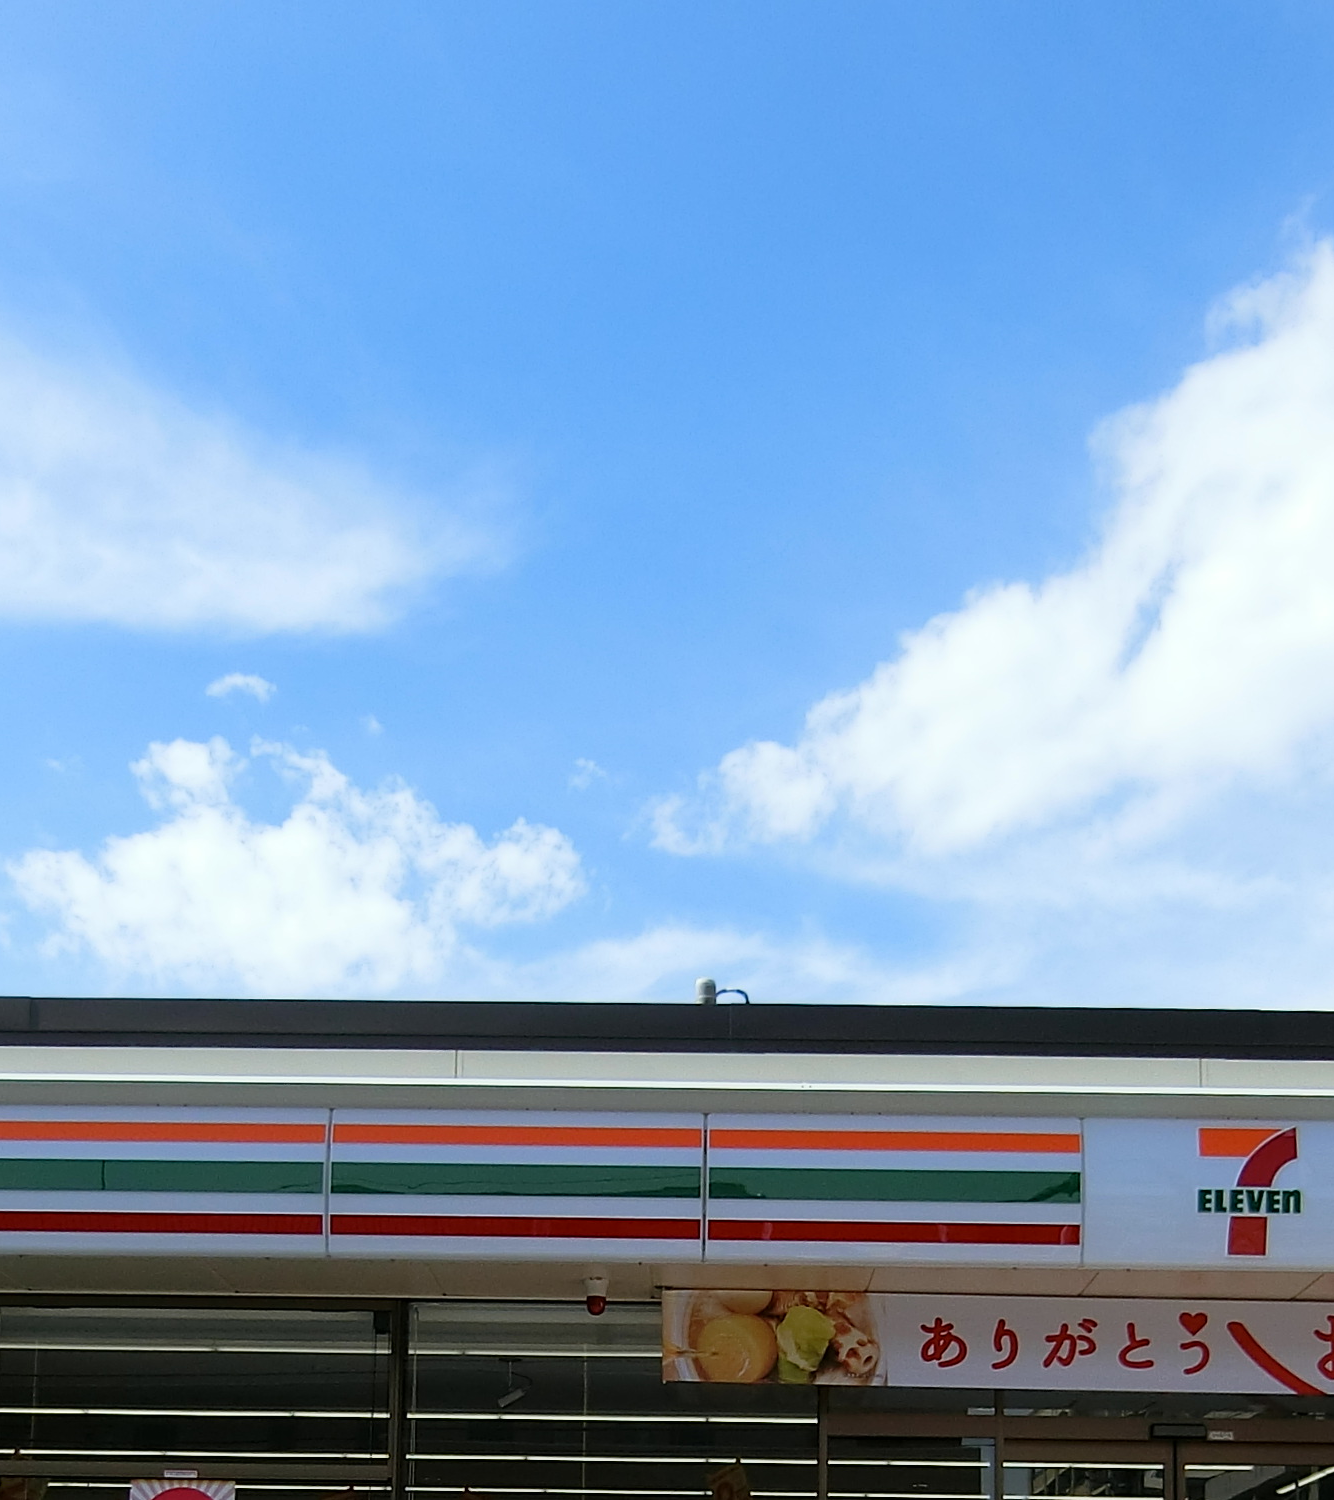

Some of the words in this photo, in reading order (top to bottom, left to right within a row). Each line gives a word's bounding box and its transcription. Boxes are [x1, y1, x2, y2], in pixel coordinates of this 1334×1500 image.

[919, 1313, 1210, 1376] ありがとう
